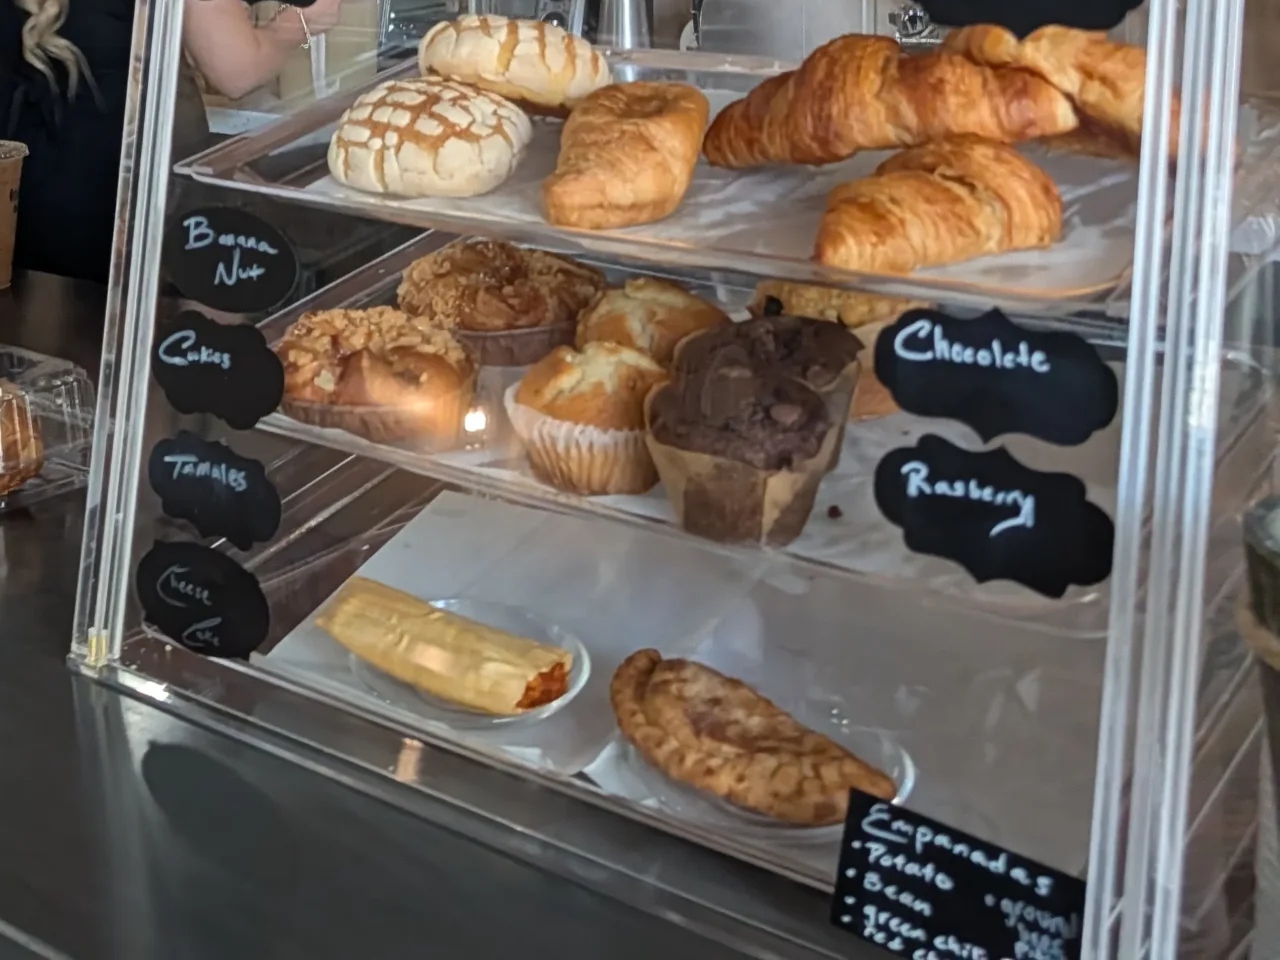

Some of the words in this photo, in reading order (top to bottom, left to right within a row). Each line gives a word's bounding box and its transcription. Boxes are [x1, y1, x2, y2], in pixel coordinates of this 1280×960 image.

[183, 216, 278, 254] Banana
[214, 248, 265, 286] Nut
[894, 319, 1051, 373] Chocolate
[163, 454, 248, 492] Tamales
[900, 460, 1035, 537] Rasberry
[157, 564, 212, 608] Cheese
[861, 803, 1055, 896] Empanadas
[864, 841, 955, 891] Potato
[863, 871, 933, 917] Bean
